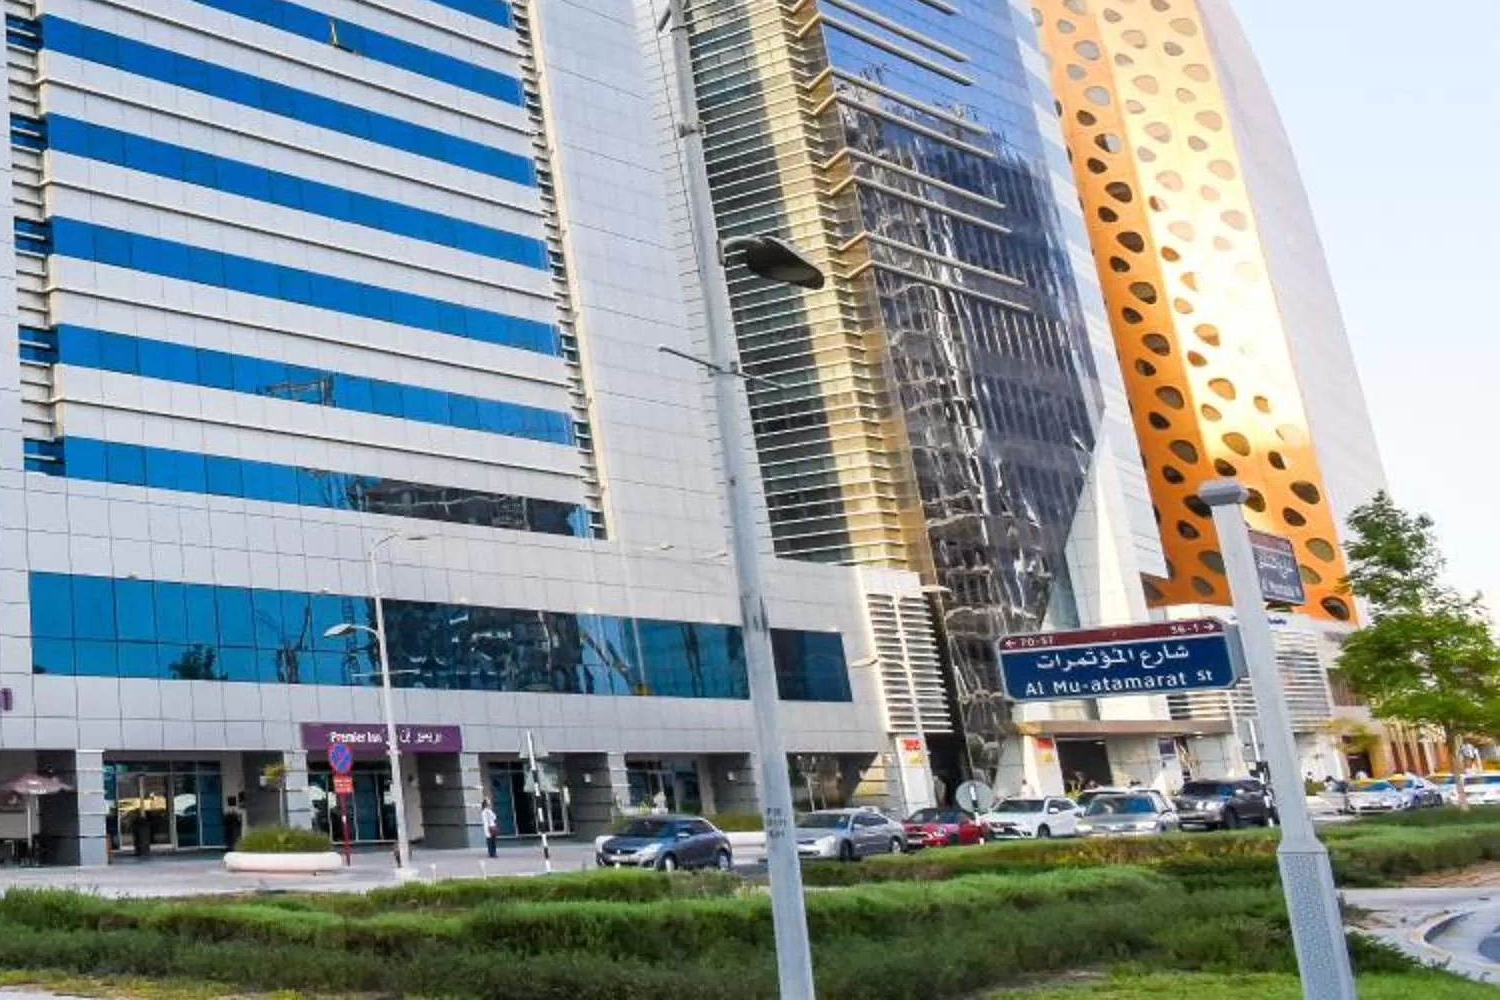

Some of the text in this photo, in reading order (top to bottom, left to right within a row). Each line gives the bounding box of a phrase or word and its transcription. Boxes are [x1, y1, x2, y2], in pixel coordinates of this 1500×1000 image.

[1035, 643, 1190, 672] شارع المؤتمرات
[1025, 681, 1045, 697] Al
[1196, 669, 1213, 682] St
